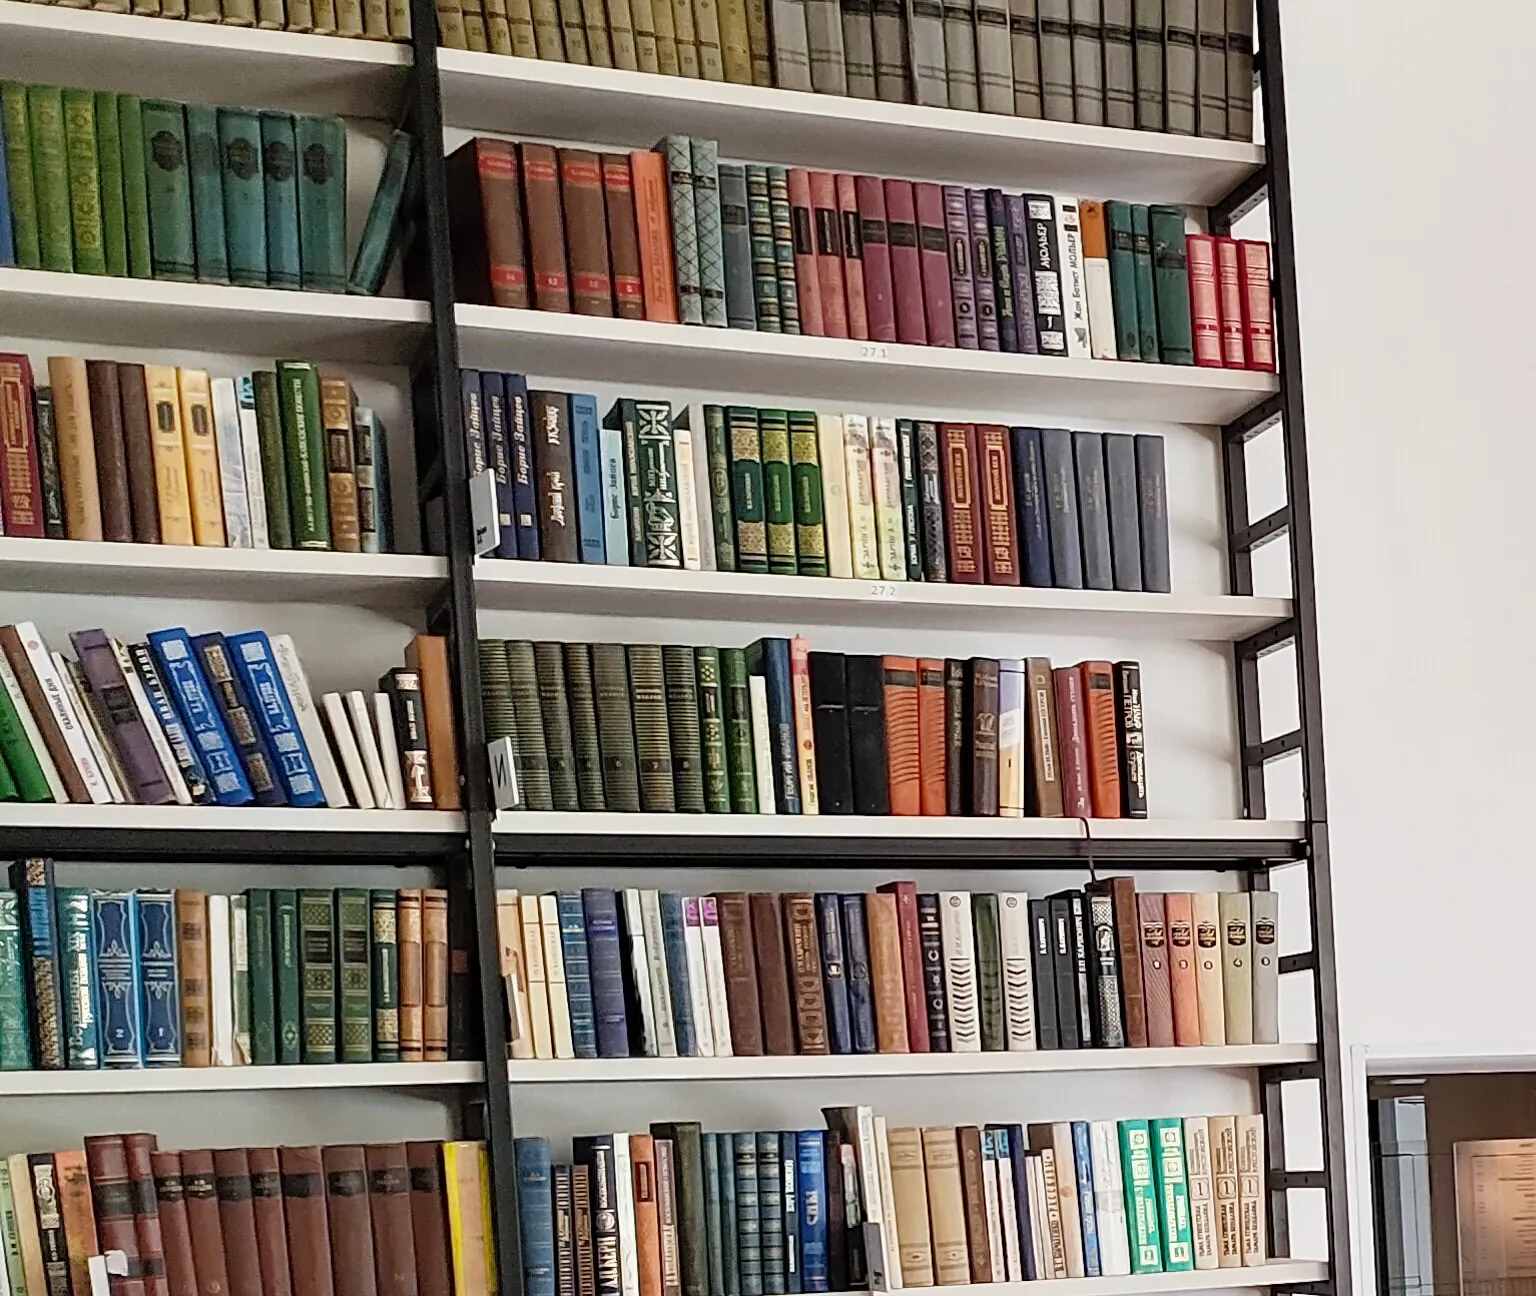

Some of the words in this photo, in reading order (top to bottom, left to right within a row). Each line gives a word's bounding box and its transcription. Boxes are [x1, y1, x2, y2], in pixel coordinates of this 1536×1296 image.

[1035, 223, 1051, 268] МОЛЬЕР
[1066, 233, 1079, 269] МОЛЬЕР
[1071, 271, 1081, 298] Батист
[1072, 301, 1082, 320] Жан
[467, 393, 481, 439] Зайцев
[490, 396, 504, 438] Зайцев
[513, 396, 527, 440] Зайцев
[471, 441, 484, 483] орис
[492, 442, 507, 484] Борис
[515, 443, 529, 485] Борис
[45, 678, 59, 692] ДНИ
[52, 694, 74, 730] ОКАЯННЫЕ
[780, 723, 791, 759] ИВАНОВ
[494, 752, 507, 790] И
[783, 762, 795, 800] ГЕОРГИЙ
[1044, 1160, 1058, 1213] РАССКАЗЫ
